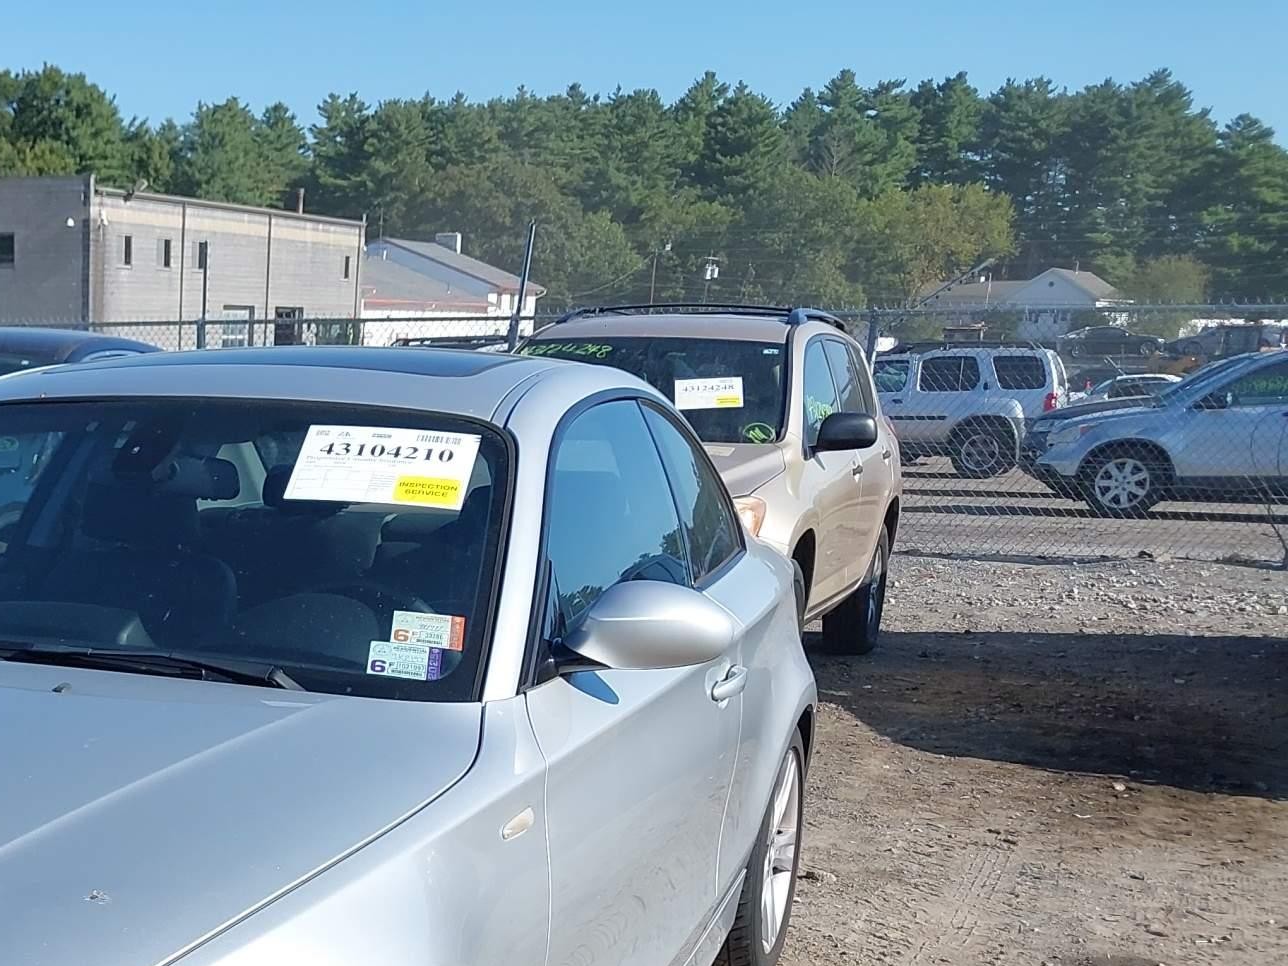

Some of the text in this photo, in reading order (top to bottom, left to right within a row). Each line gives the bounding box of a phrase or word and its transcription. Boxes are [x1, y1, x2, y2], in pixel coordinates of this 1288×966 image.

[319, 441, 455, 464] 43104210
[399, 481, 458, 492] INSPECTION
[404, 488, 449, 498] SERVICE
[393, 628, 410, 643] 6
[370, 659, 387, 673] 6
